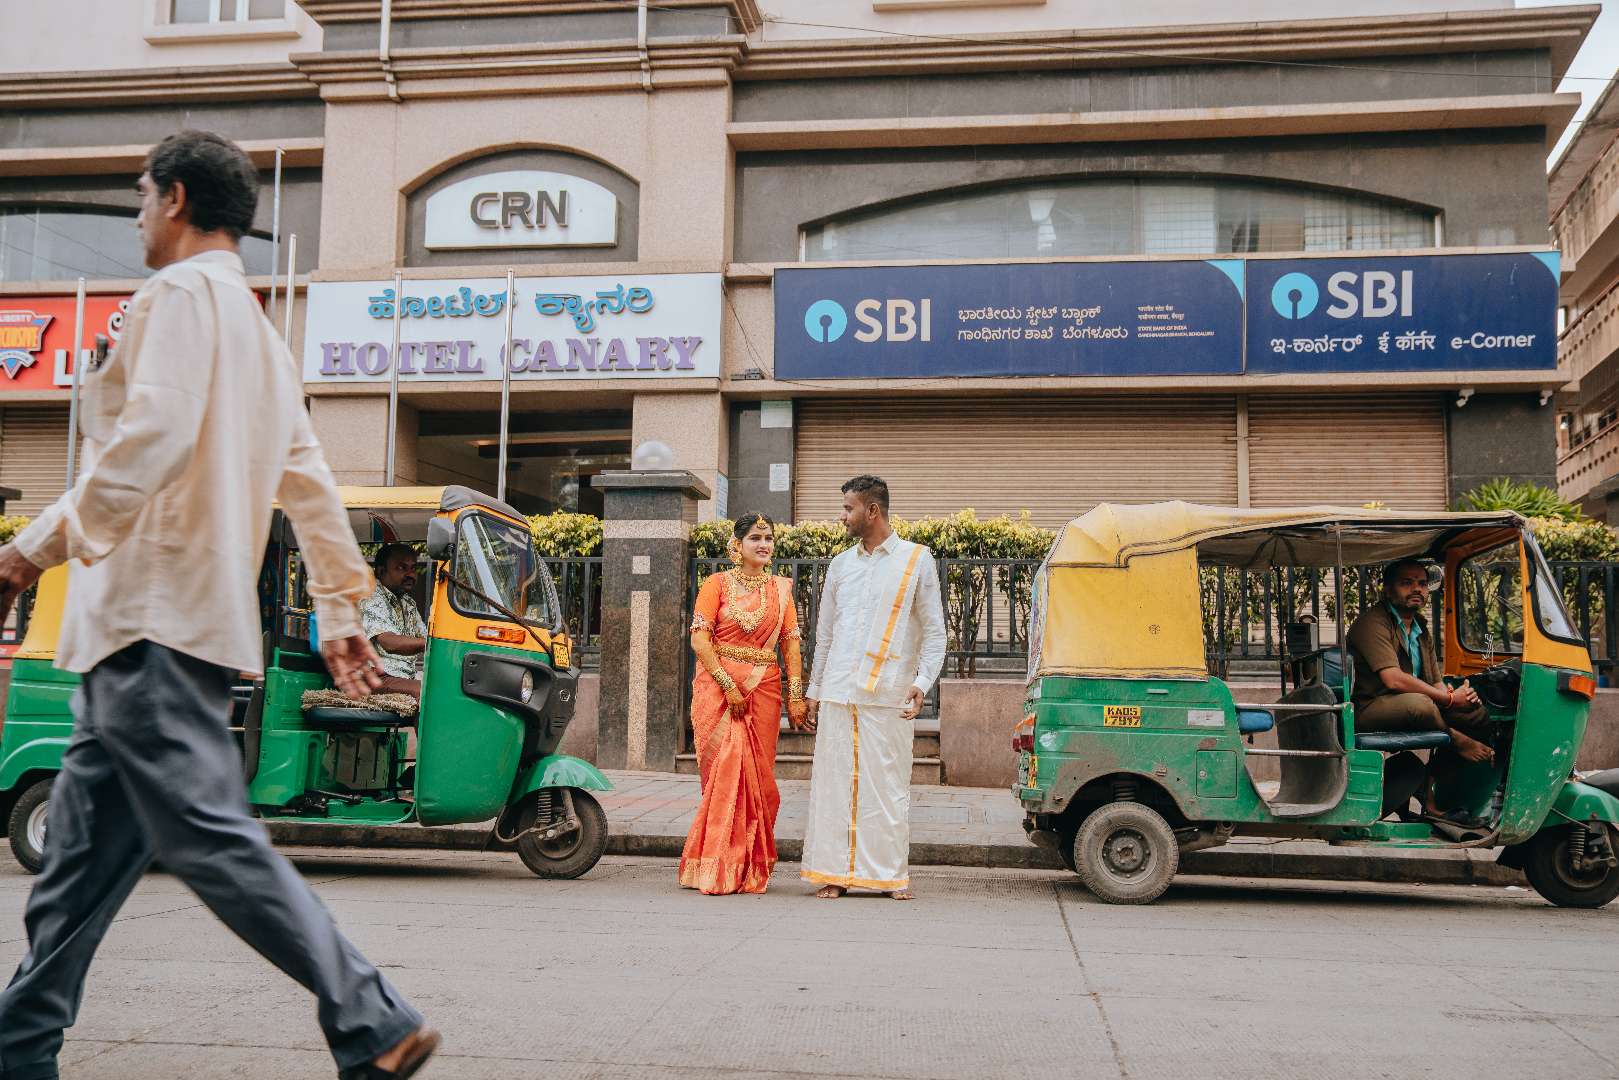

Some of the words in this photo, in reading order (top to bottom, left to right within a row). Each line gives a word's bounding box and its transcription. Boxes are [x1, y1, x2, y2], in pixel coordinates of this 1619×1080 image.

[470, 190, 569, 228] CRN
[535, 283, 654, 333] ಕ್ಯಾನರಿ
[1326, 270, 1413, 319] SBI
[854, 298, 931, 343] SBI
[958, 306, 1021, 323] ಭಾರತೀಯ
[319, 341, 483, 375] HOTEL
[500, 336, 702, 373] CANARY
[1378, 332, 1390, 353] ई
[1395, 331, 1436, 351] कॉर्नर
[1451, 331, 1536, 349] e-Corner
[1107, 707, 1138, 716] KA05
